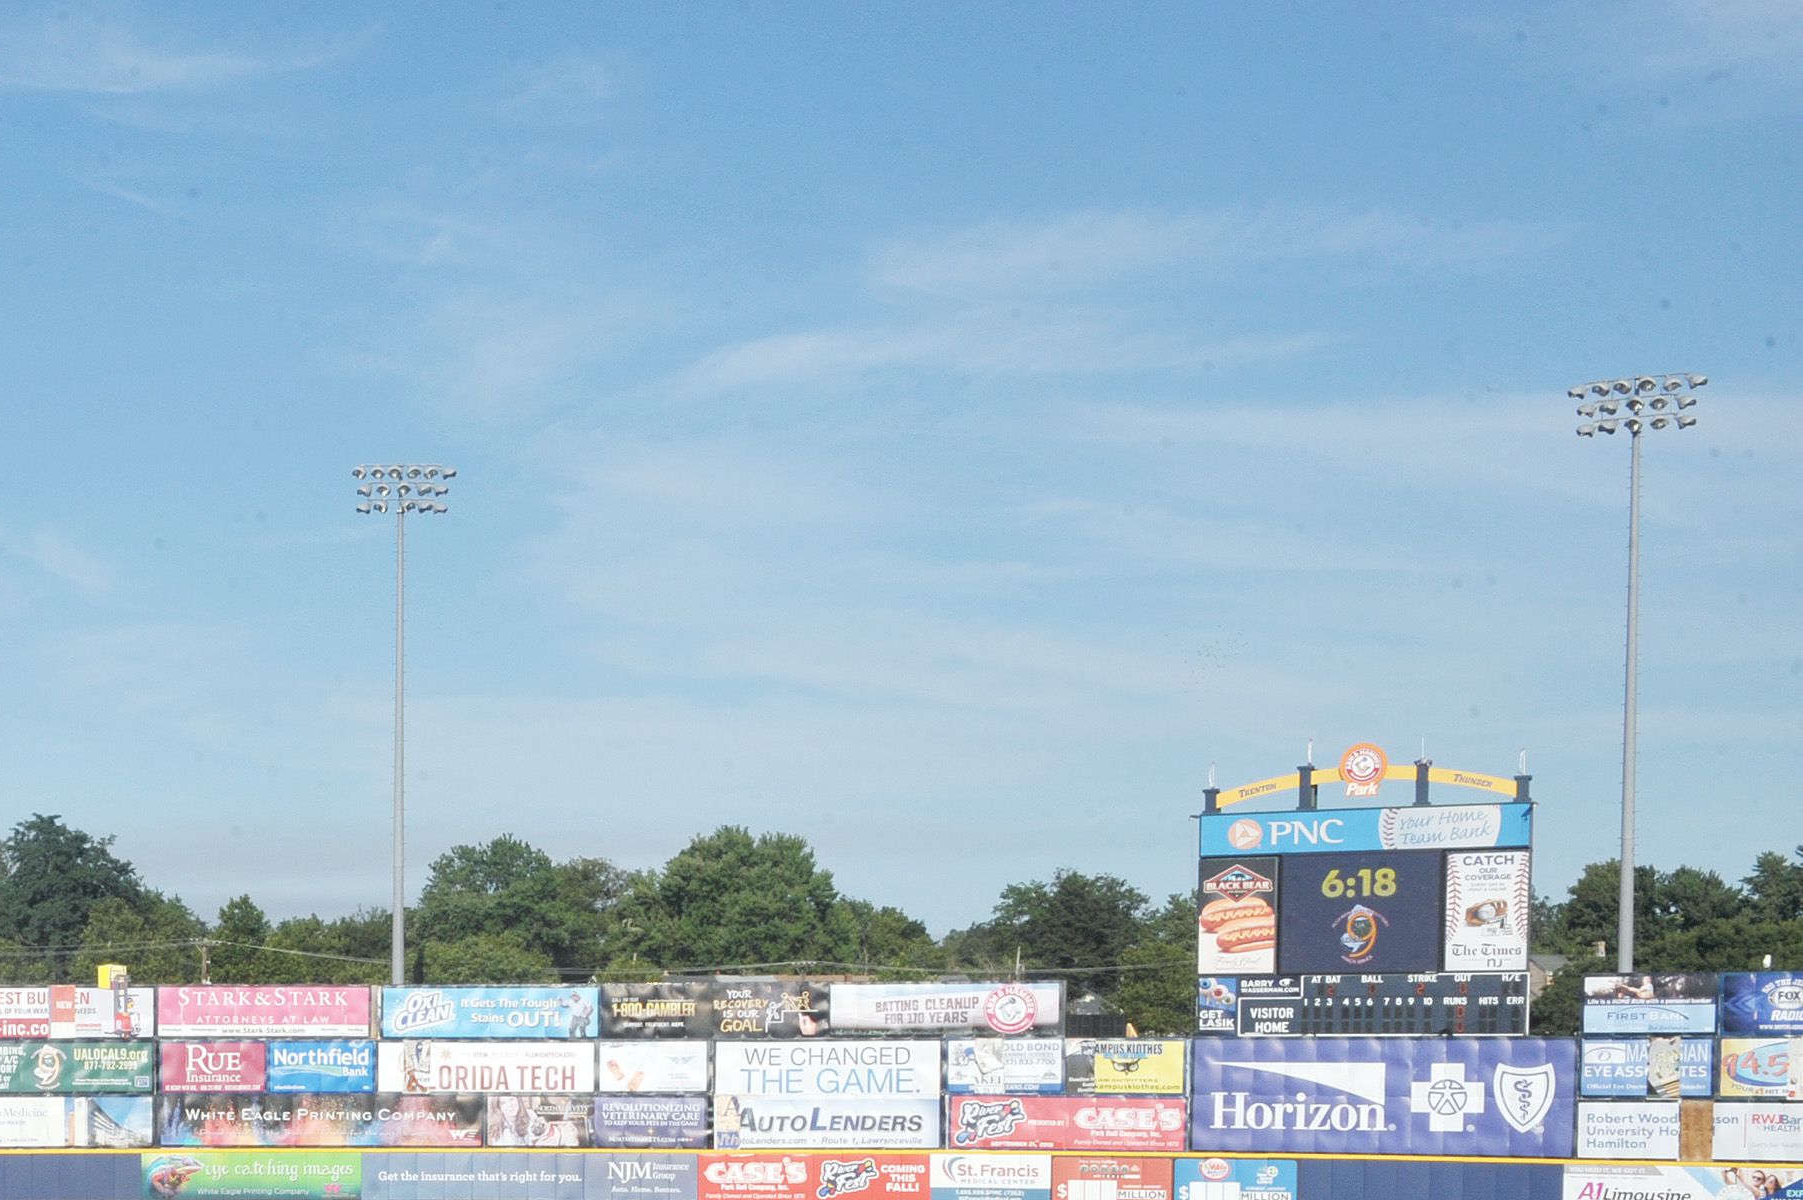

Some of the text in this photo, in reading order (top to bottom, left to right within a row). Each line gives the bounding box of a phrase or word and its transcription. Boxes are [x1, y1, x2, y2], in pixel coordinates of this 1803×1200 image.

[1453, 773, 1494, 788] THUNDER
[1238, 783, 1278, 798] TRENTON
[1346, 782, 1379, 796] Park
[1398, 809, 1487, 831] Your Home
[1268, 819, 1344, 846] PNC
[1400, 824, 1492, 845] Team Bank
[1463, 855, 1514, 866] CATCH
[1206, 881, 1270, 891] BLACK BEAR
[1321, 868, 1397, 898] 6:18
[1452, 943, 1522, 956] The Times
[1240, 980, 1274, 988] BARRY
[1361, 975, 1384, 983] BALL
[727, 989, 752, 999] YOUR
[1778, 991, 1801, 1000] FOX
[56, 1001, 74, 1009] NEW
[407, 993, 439, 1013] OXI
[460, 998, 557, 1009] It Gets The Tough
[713, 999, 768, 1009] RECOVERY
[876, 997, 979, 1012] BATTING CLEANUP
[1443, 997, 1467, 1005] RUNS
[1479, 997, 1498, 1005] HITS
[1506, 997, 1524, 1005] ERR
[612, 1002, 696, 1017] 1-800-GAMBLER
[723, 1010, 760, 1018] IS OUR
[1199, 1010, 1223, 1019] GET
[1250, 1007, 1294, 1019] VISITOR
[196, 1015, 330, 1024] ATTORNEYS AT LAW
[395, 1003, 454, 1030] CLEAN
[471, 1011, 561, 1028] Stains OUT!
[885, 1011, 968, 1024] FOR YEARS
[1607, 1012, 1647, 1020] FIRST
[720, 1019, 763, 1033] GOAL
[1199, 1019, 1235, 1027] LASIK
[1256, 1021, 1289, 1033] HOME
[1027, 1043, 1060, 1051] BOND
[1127, 1043, 1163, 1054] KLOTHES
[1, 1056, 19, 1065] A/C
[73, 1048, 149, 1062] UALOCAL9.org
[185, 1044, 242, 1074] RUE
[274, 1048, 369, 1066] Northfield
[744, 1046, 911, 1065] WE CHANGED
[185, 1071, 241, 1083] Insurance
[342, 1067, 368, 1076] Bank
[516, 1065, 575, 1090] TECH
[1584, 1066, 1611, 1077] EYE
[740, 1068, 921, 1094] THE GAME.
[601, 1103, 700, 1112] REVOLUTIONIZING
[1209, 1091, 1387, 1131] Horizon
[185, 1108, 456, 1121] WHITE EAGLE PRINTING COMPANY
[601, 1112, 700, 1120] VETERINARY CARE
[1073, 1103, 1181, 1131] CASE'S
[1586, 1113, 1679, 1124] Robert Wood
[1586, 1126, 1653, 1137] University
[1586, 1138, 1646, 1149] Hamilton
[205, 1159, 353, 1182] eye catching images
[608, 1161, 690, 1183] NJM Insurance
[704, 1157, 808, 1184] CASE'S
[880, 1164, 925, 1173] COMING
[957, 1163, 1039, 1177] St. Francis
[378, 1171, 582, 1184] Get the insurance that's right for you.
[652, 1171, 676, 1181] Group
[890, 1173, 916, 1182] THIS
[197, 1187, 310, 1196] White Eagle Printing Company
[886, 1182, 919, 1192] FALL!
[1057, 1184, 1166, 1199] $ MILLION
[1178, 1186, 1289, 1200] $ MILLION
[1578, 1182, 1604, 1200] A1
